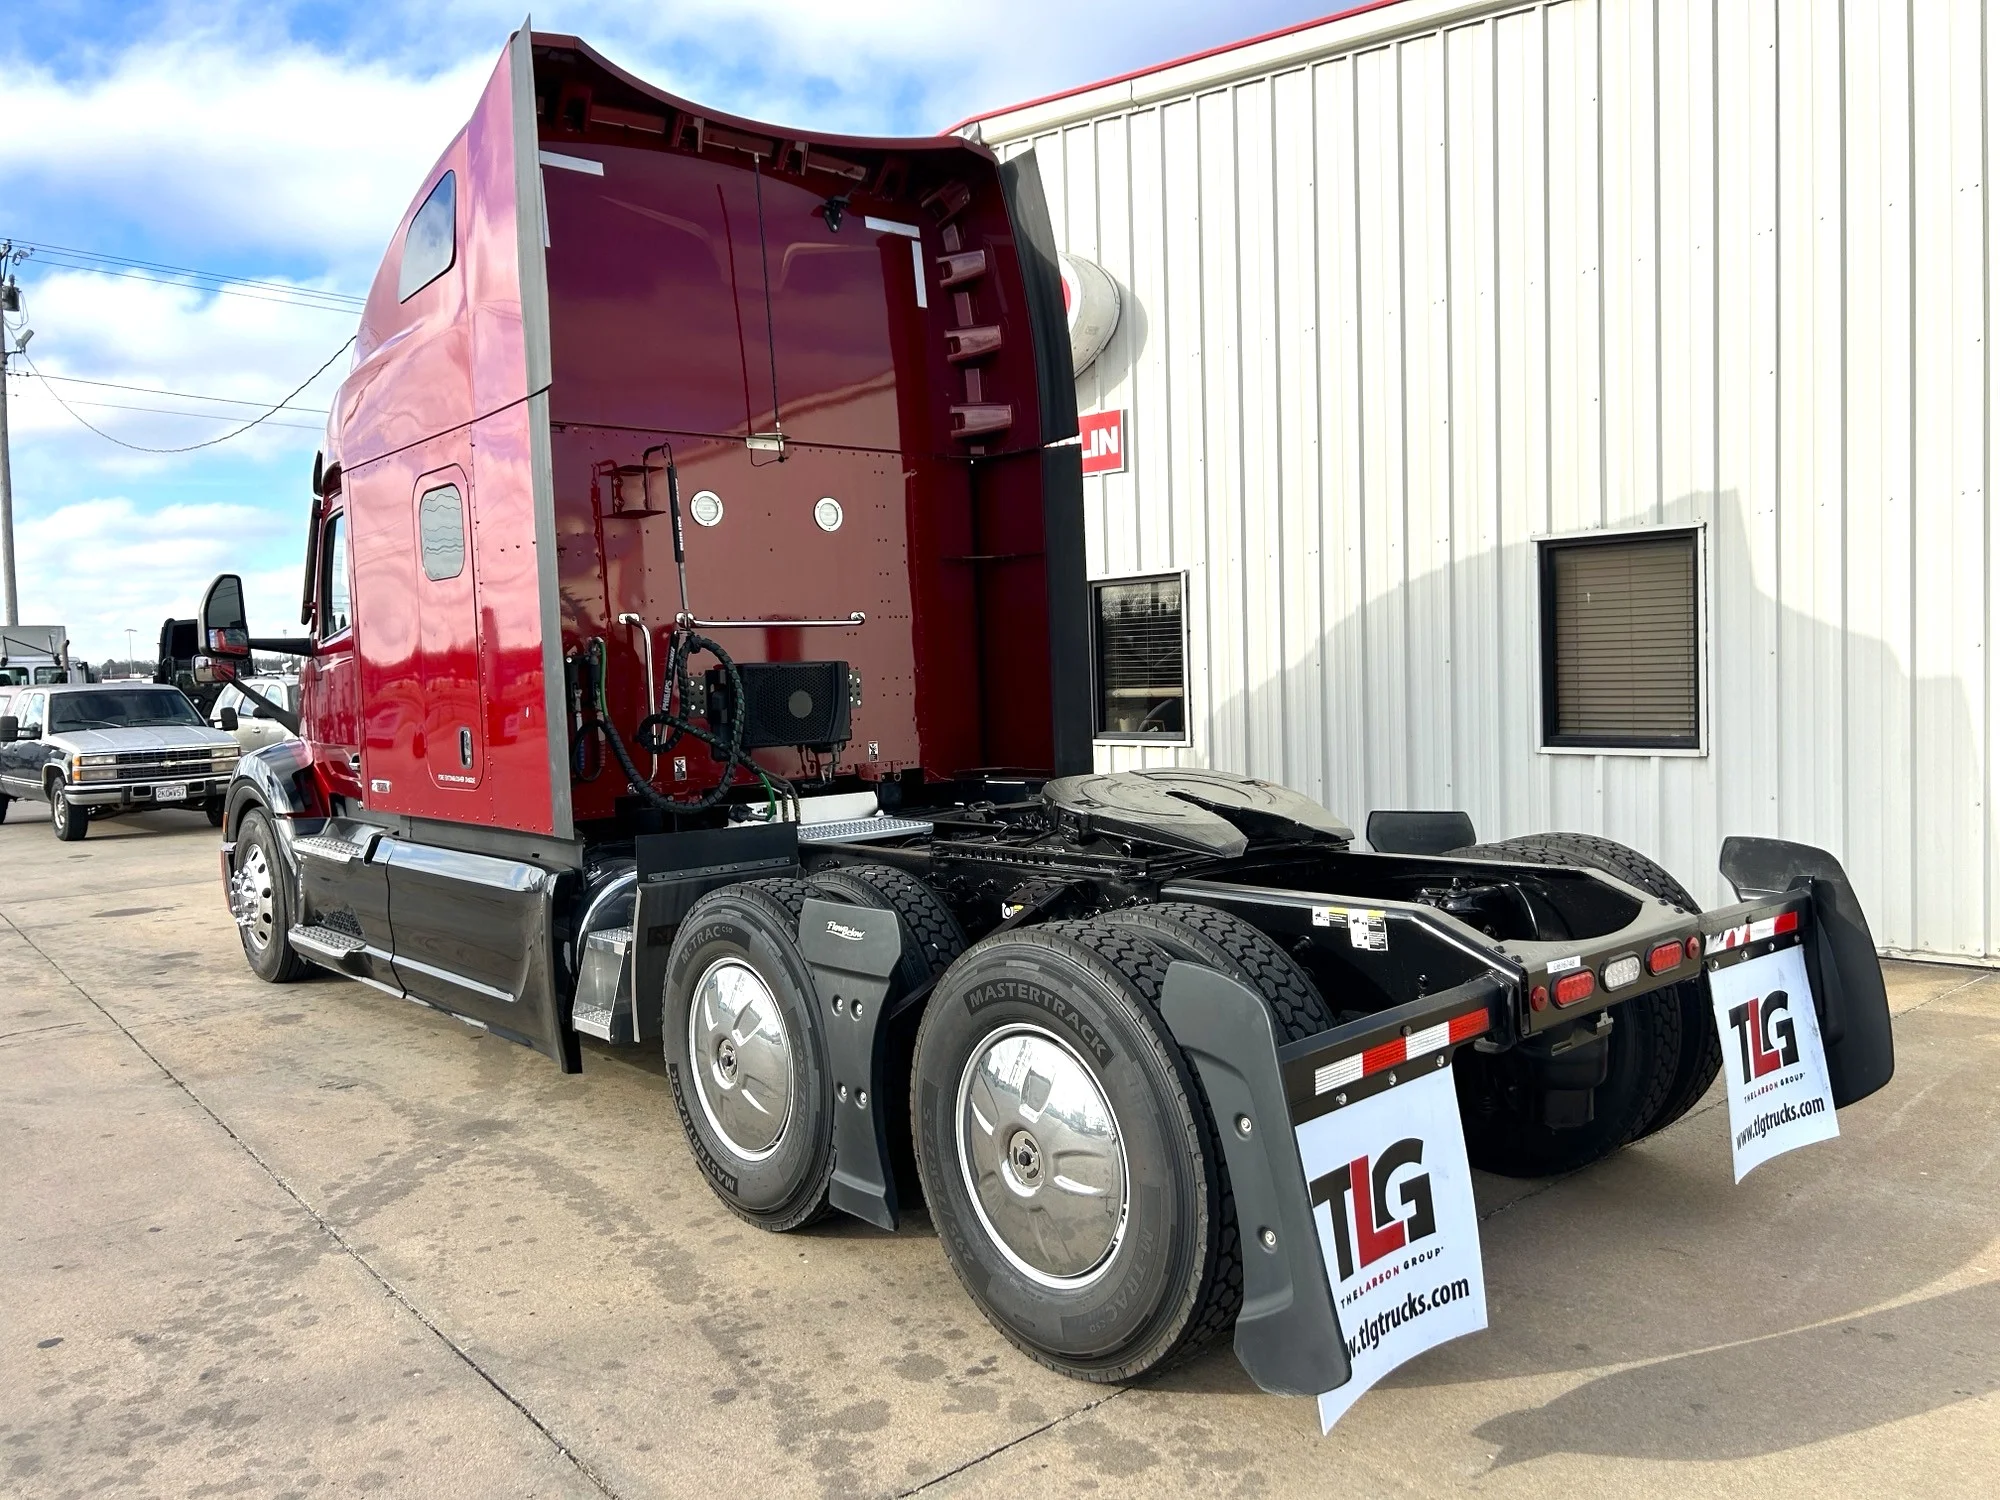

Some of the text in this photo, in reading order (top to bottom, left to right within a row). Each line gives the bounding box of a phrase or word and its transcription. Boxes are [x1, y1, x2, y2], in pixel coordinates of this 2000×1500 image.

[681, 926, 721, 964] M-TRAC
[969, 982, 1107, 1058] MASTERTRACK
[1728, 989, 1800, 1085] TLG
[1780, 1072, 1804, 1086] GROUP
[670, 1070, 735, 1191] MASTERTRACK
[1735, 1097, 1825, 1151] www.tlgtrucks.com
[1309, 1137, 1436, 1283] TLG
[1403, 1247, 1443, 1270] GROUP
[1345, 1276, 1470, 1362] w.tlgtrucks.com
